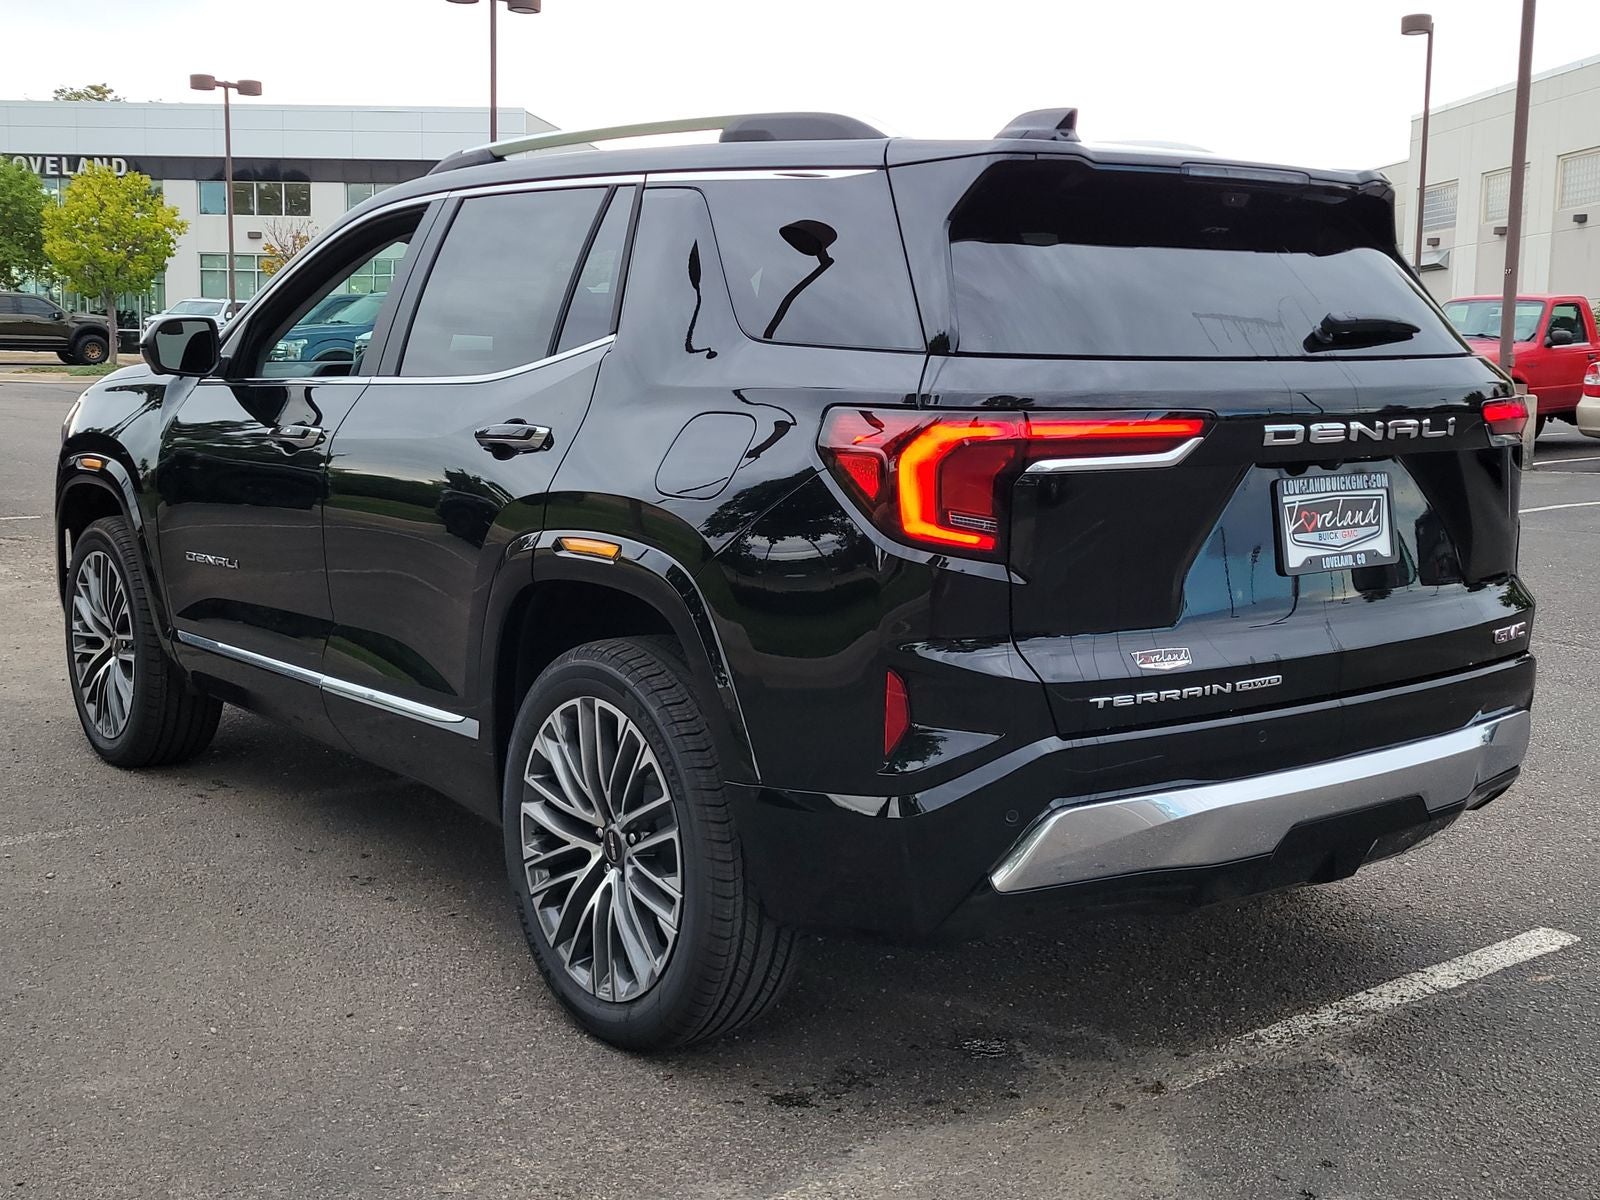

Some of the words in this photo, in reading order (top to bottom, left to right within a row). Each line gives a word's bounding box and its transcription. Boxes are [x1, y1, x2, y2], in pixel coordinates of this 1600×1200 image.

[12, 155, 128, 176] OVELAND
[1263, 416, 1456, 446] DENALI
[1318, 531, 1339, 541] BUICK
[1341, 529, 1359, 539] GMC
[185, 551, 238, 569] DENALI
[1089, 682, 1232, 709] TERRAIN
